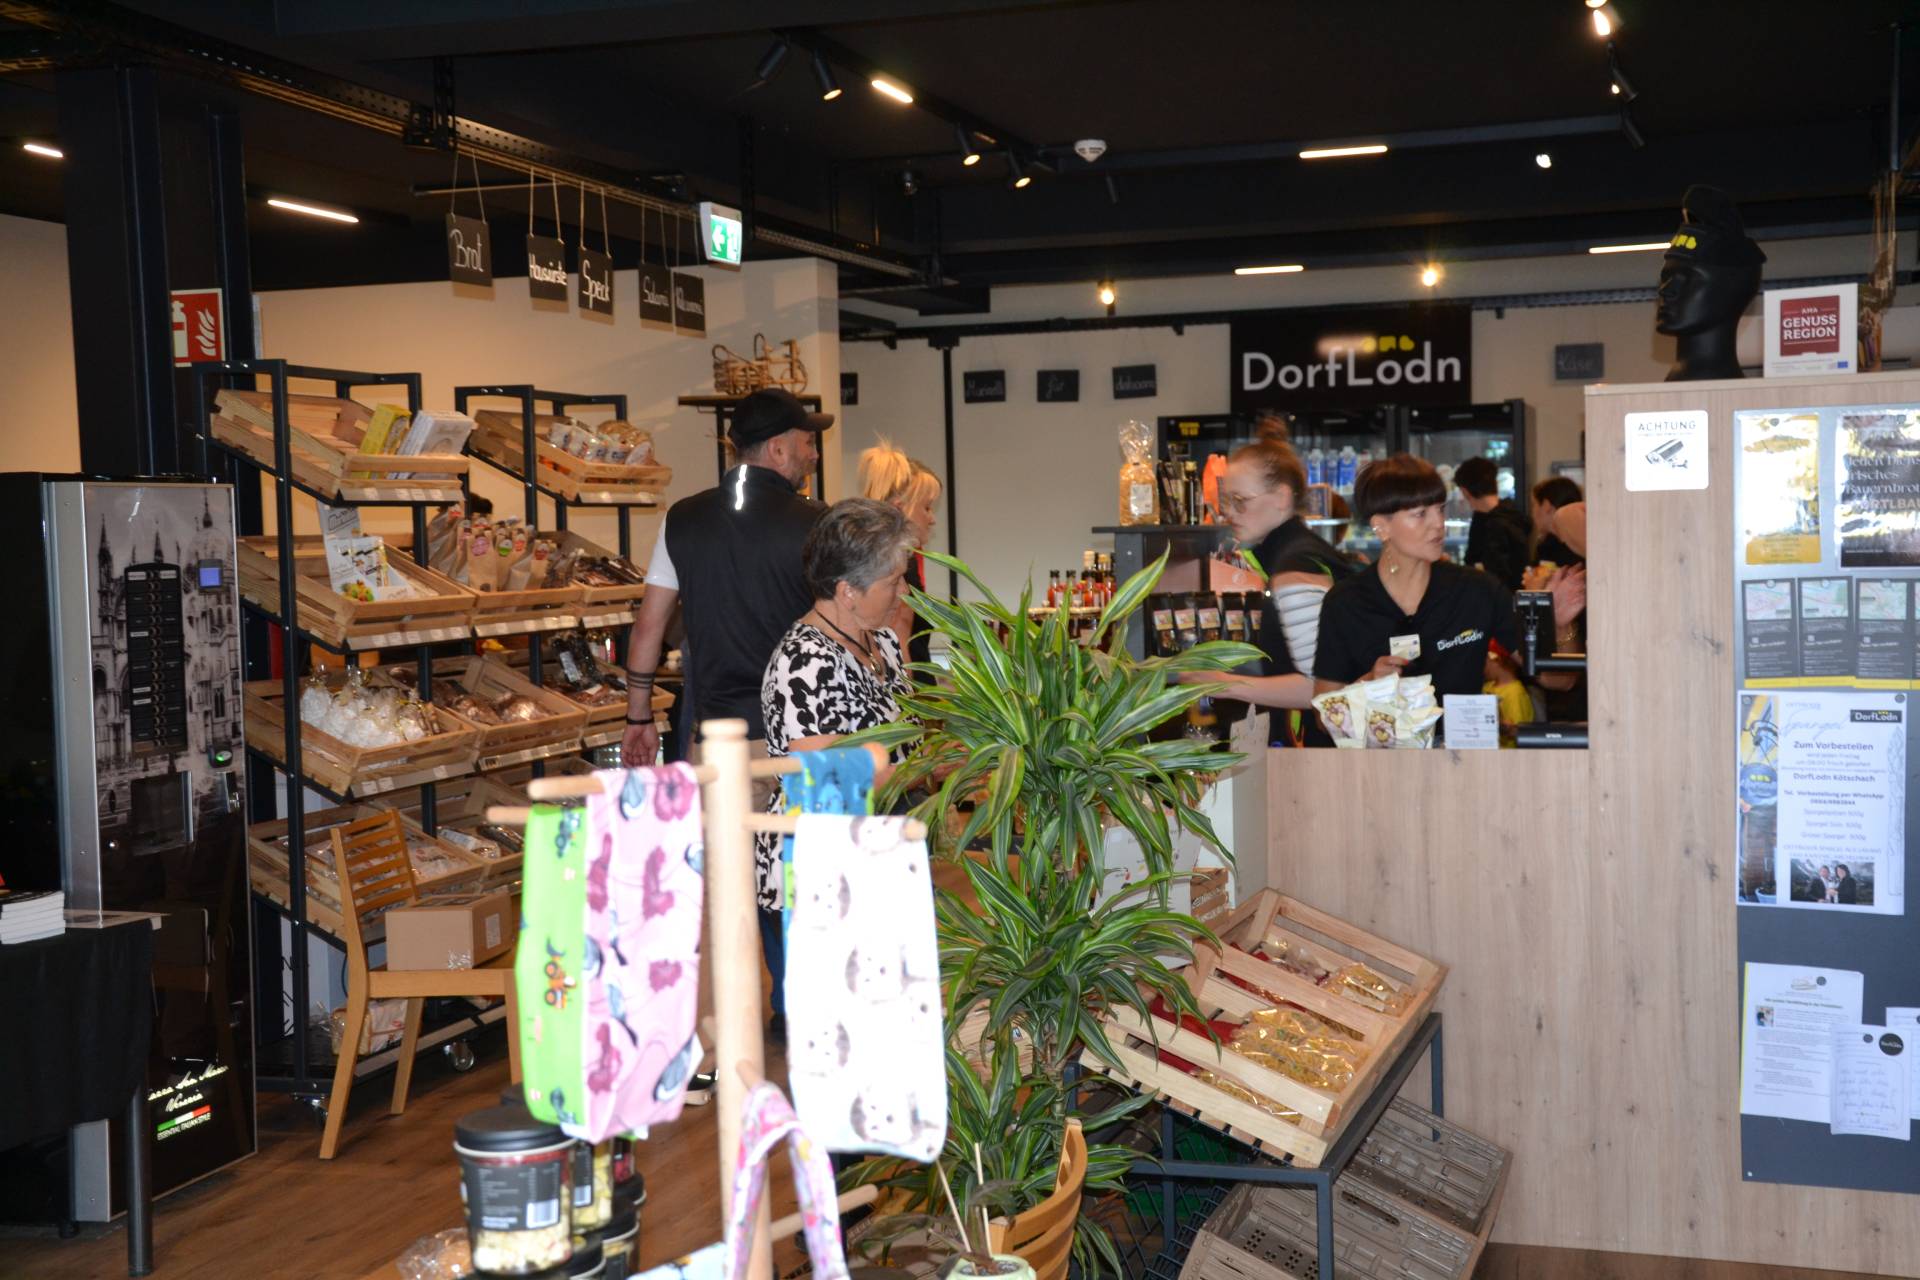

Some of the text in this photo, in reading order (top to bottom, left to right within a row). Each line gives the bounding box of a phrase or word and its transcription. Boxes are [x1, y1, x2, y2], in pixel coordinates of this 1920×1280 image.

[450, 228, 484, 273] Brot
[582, 259, 611, 309] Speck
[1801, 307, 1819, 315] AMA
[1783, 314, 1837, 329] GENUSS
[1784, 326, 1836, 340] REGION
[1243, 341, 1461, 390] DorfLodn
[1638, 420, 1696, 432] ACHTUNG
[1854, 710, 1899, 721] DorfLodn
[1793, 741, 1874, 751] Zum Vorbestellen
[1793, 773, 1831, 781] DorfLodn
